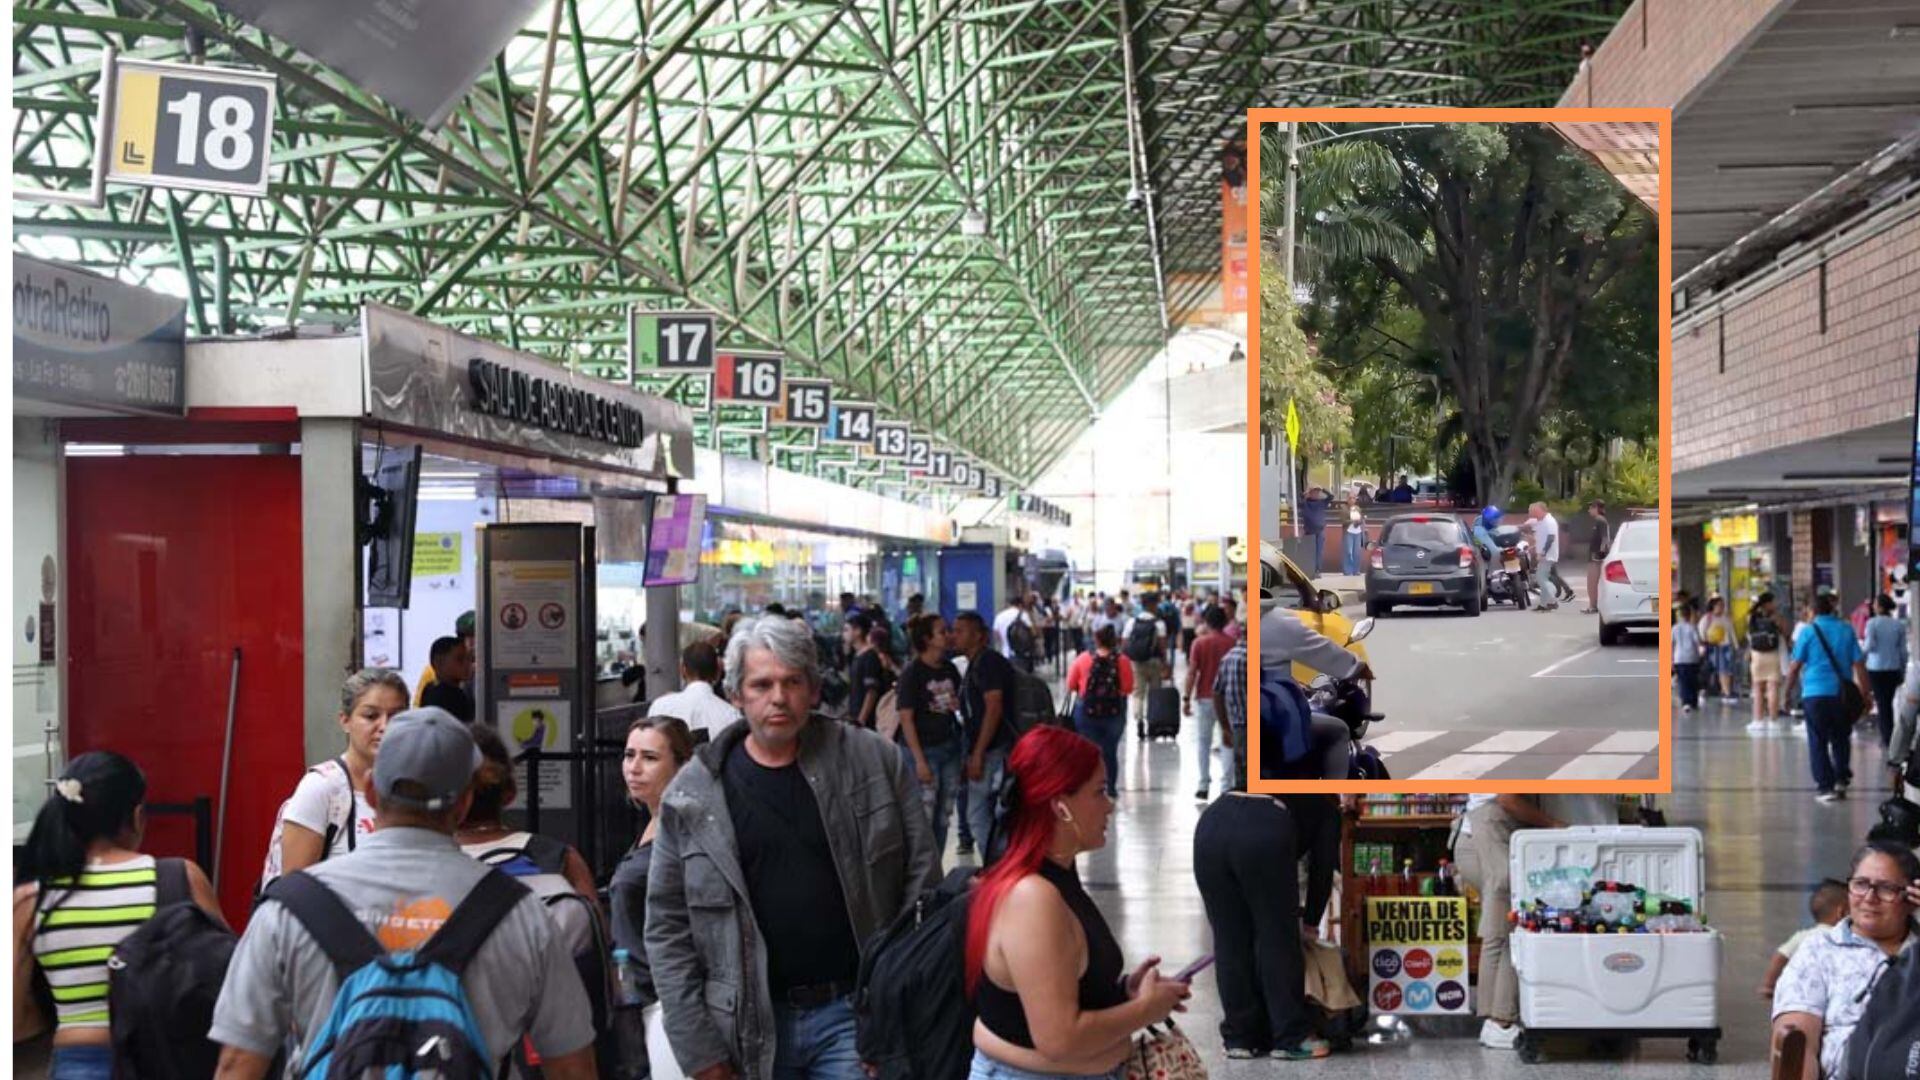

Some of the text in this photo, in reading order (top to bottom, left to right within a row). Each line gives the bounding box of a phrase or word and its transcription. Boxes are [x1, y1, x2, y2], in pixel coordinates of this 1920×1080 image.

[166, 91, 254, 171] 18
[661, 323, 708, 362] 17
[469, 358, 518, 420] SALA
[736, 361, 776, 397] 16
[789, 387, 824, 420] 15
[838, 410, 870, 439] 14
[876, 428, 905, 454] 13
[1376, 901, 1459, 920] VENTA DE
[1370, 921, 1465, 943] PAQUETES
